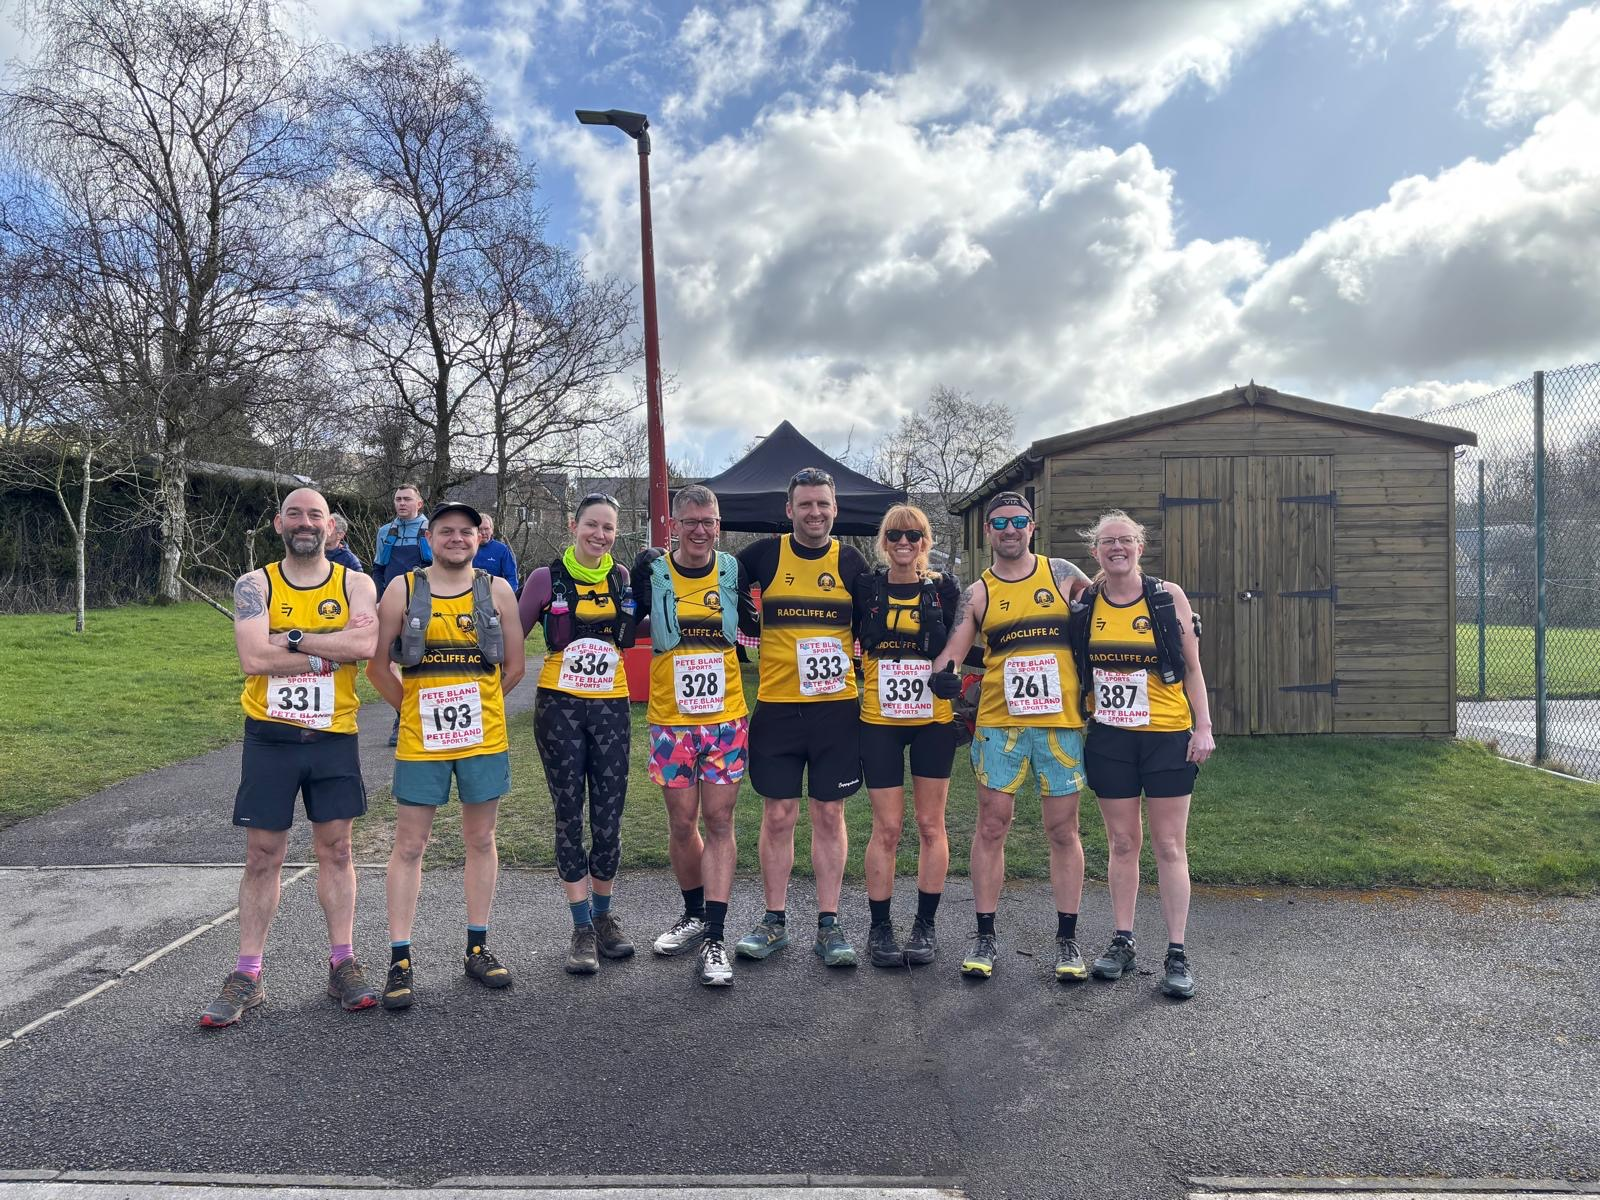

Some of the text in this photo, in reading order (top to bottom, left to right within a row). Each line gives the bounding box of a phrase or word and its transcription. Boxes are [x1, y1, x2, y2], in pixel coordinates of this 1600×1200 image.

[777, 609, 824, 618] RADCLIFFE
[681, 628, 710, 637] CLIFFE
[1000, 628, 1059, 643] RADCLIFFE AC
[422, 654, 480, 663] ADCLIFFE AC
[698, 657, 722, 665] BLAND
[1028, 658, 1056, 666] BLAND
[1090, 653, 1141, 662] RADCLIFFE
[570, 653, 609, 675] 336
[806, 656, 842, 680] 333
[563, 673, 585, 683] PETE
[681, 672, 718, 697] 328
[886, 678, 924, 701] 339
[1012, 674, 1049, 698] 261
[278, 686, 320, 711] 331
[422, 687, 477, 700] PETE BLAND
[1100, 684, 1138, 708] 387
[436, 696, 463, 704] SPORTS
[1033, 697, 1060, 705] BLAND
[433, 704, 471, 731] 193
[426, 728, 481, 740] PETE BLAND
